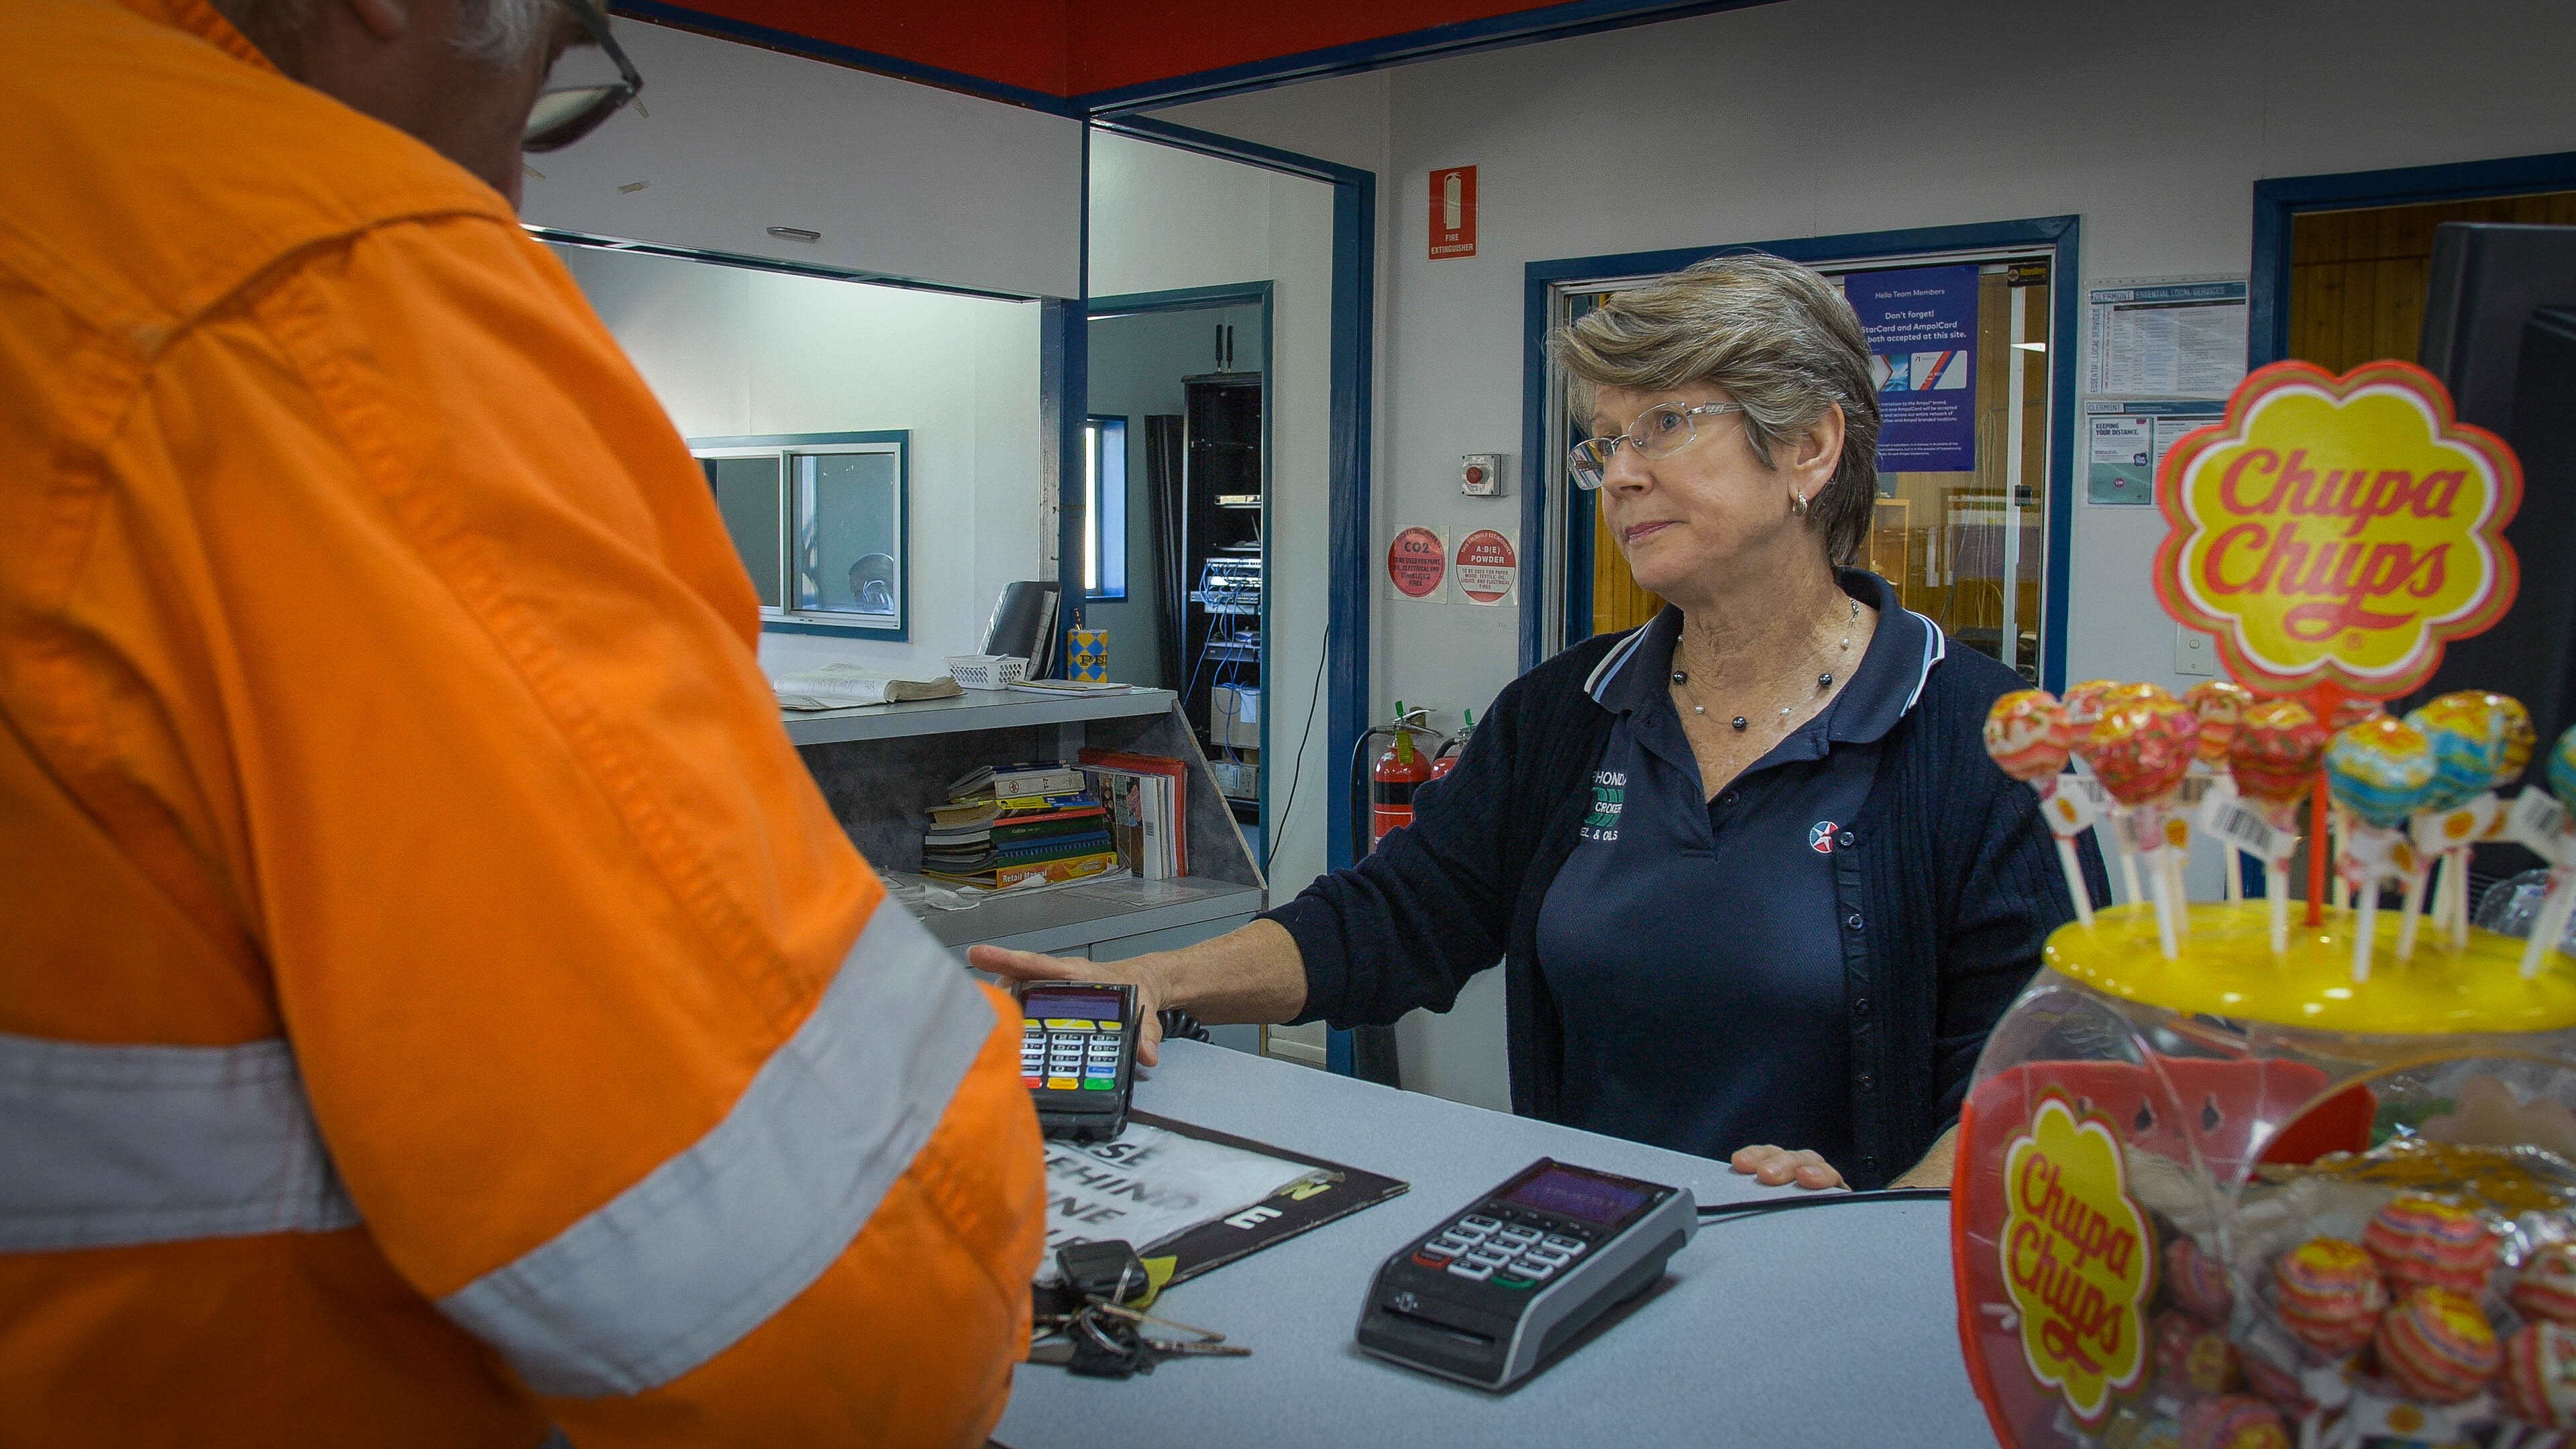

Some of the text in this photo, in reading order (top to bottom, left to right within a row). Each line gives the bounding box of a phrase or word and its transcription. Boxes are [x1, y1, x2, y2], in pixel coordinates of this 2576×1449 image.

[1446, 233, 1460, 241] FIRE
[1431, 243, 1473, 254] EXTINGUISHER
[1885, 309, 1935, 320] Don't forget!
[1862, 321, 1957, 334] StarCard and AmpolCard
[1868, 335, 1885, 343] both
[1886, 333, 1921, 343] accepted
[1933, 331, 1948, 339] this
[1949, 331, 1967, 339] site.
[2219, 448, 2470, 537] Chupa
[1405, 541, 1429, 553] CO2
[1470, 555, 1505, 564] POWDER
[2203, 523, 2455, 640] Chups
[1593, 829, 1600, 840] &
[1003, 873, 1022, 883] Retail
[2021, 1152, 2137, 1281] Chupa
[2012, 1221, 2124, 1374] Chups
